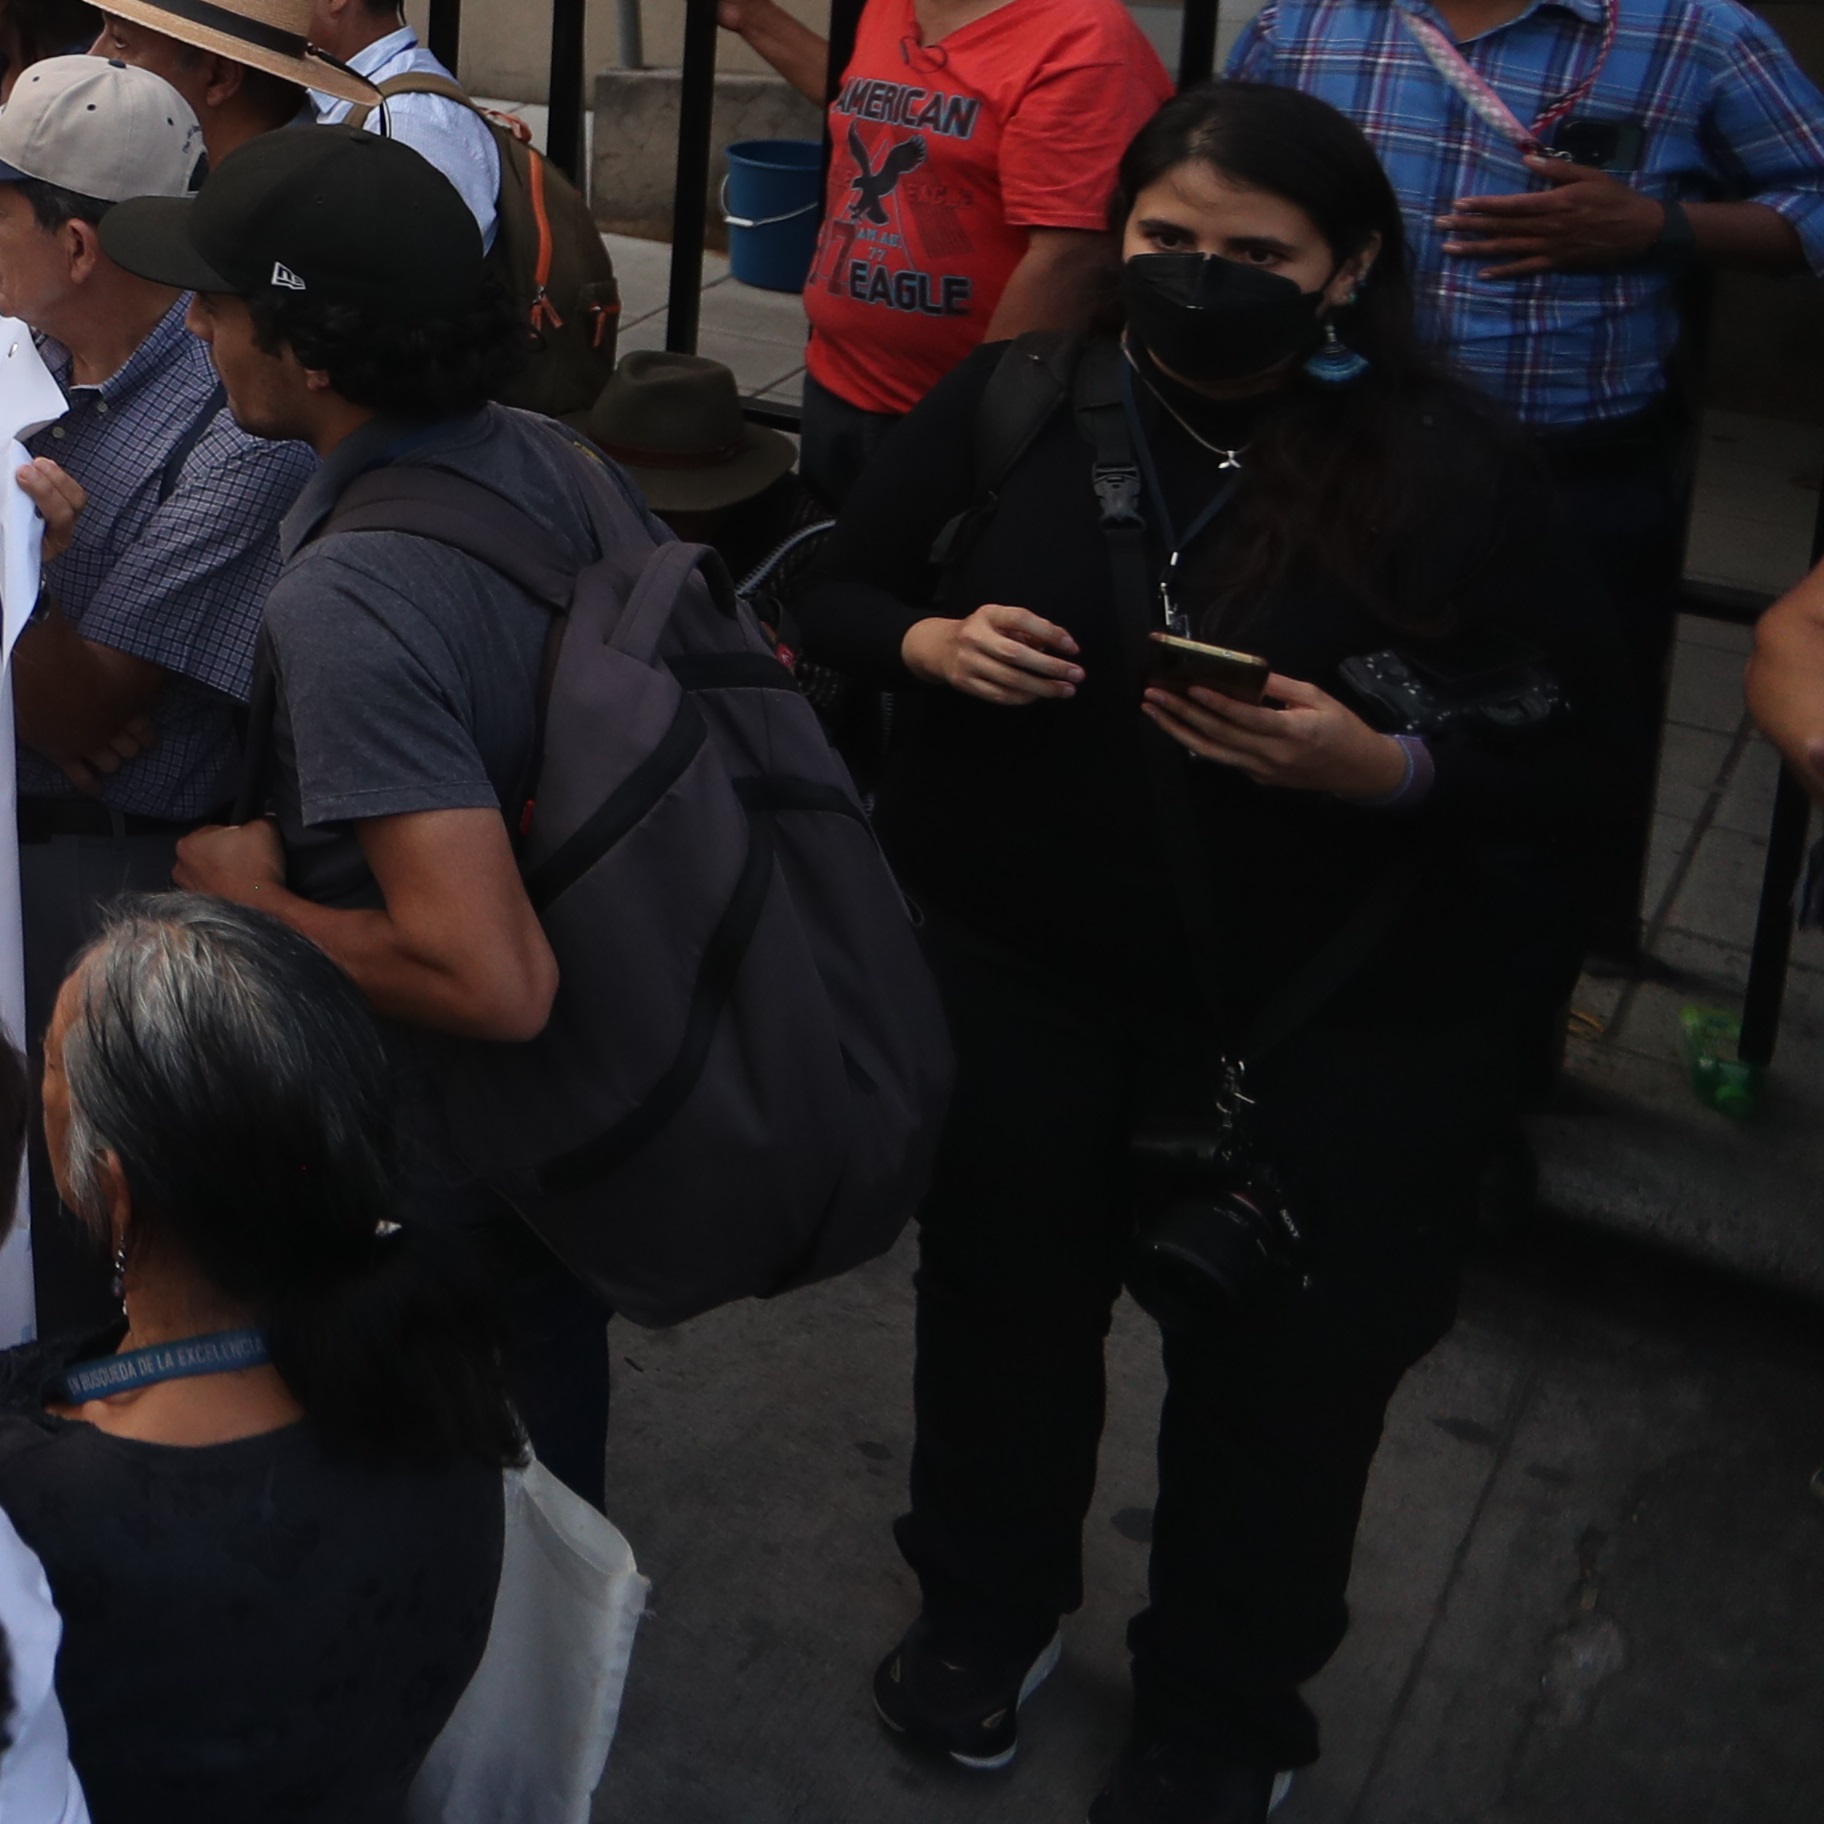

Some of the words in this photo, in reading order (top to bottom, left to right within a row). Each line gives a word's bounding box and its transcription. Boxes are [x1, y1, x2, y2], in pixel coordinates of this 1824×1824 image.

[831, 76, 984, 141] AMERICAN
[849, 259, 971, 317] EAGLE
[79, 1360, 138, 1392] BUSQUEDA
[138, 1356, 156, 1377] DE
[156, 1352, 176, 1371] LA
